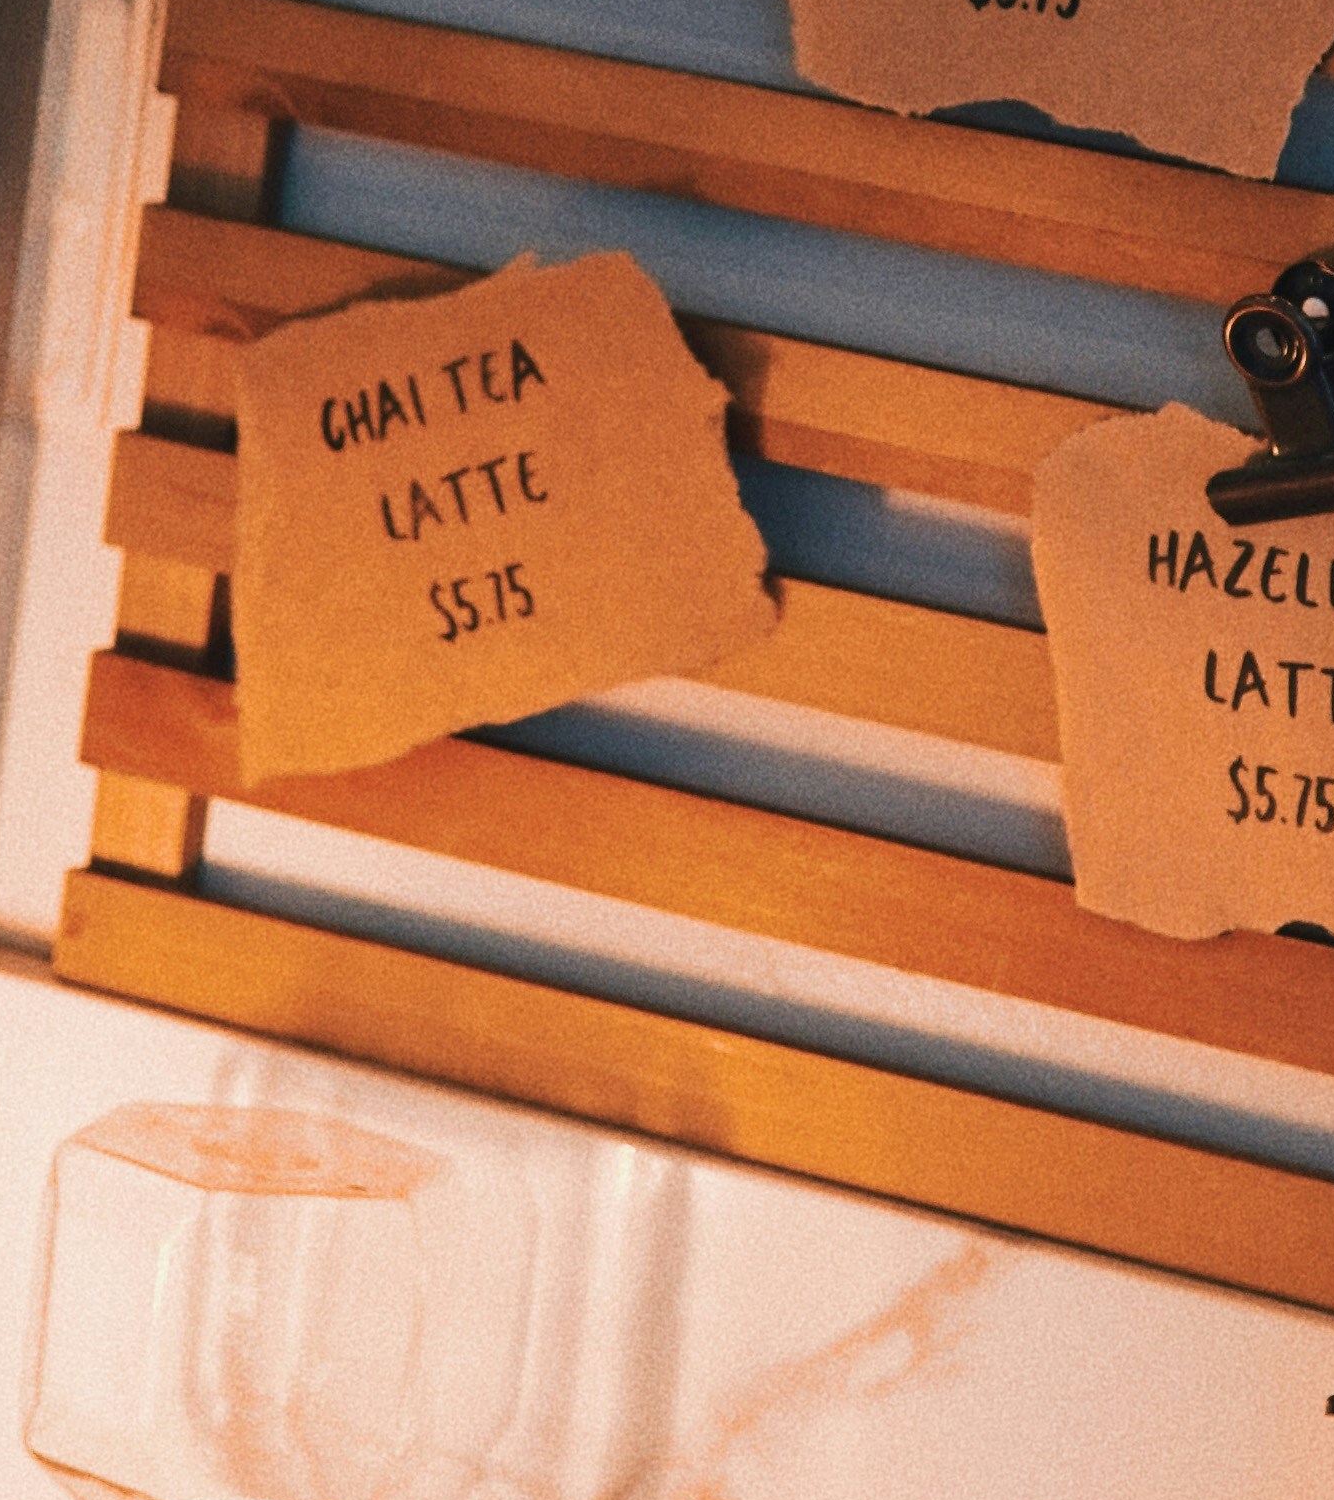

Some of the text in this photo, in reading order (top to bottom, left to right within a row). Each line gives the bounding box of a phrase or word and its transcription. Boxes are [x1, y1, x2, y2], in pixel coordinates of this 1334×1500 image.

[321, 340, 544, 452] CHAI TEA
[380, 452, 548, 540] LATTE
[429, 563, 534, 643] $5.75
